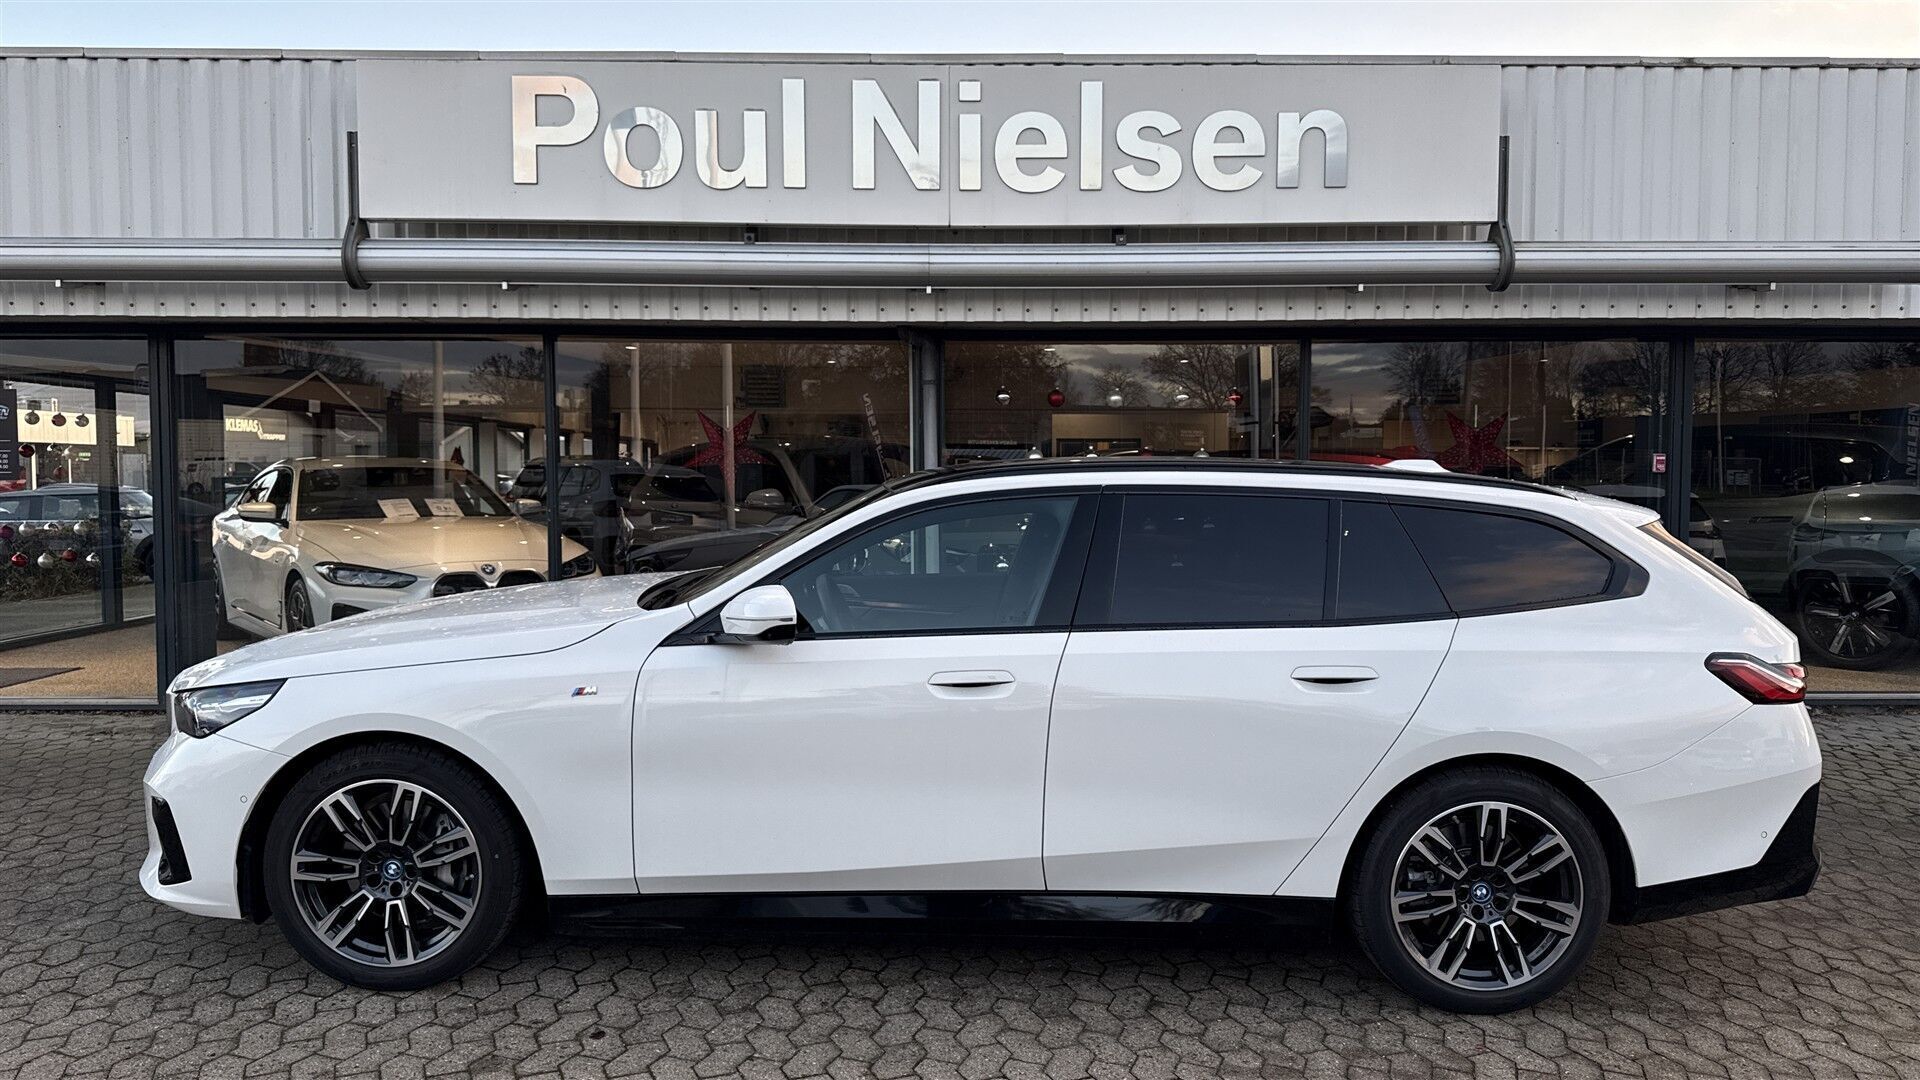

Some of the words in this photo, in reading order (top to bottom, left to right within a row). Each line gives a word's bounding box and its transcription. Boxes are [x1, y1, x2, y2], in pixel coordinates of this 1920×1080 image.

[511, 75, 806, 190] Poul
[852, 78, 1349, 193] Nielsen
[225, 418, 259, 433] KLEMAS
